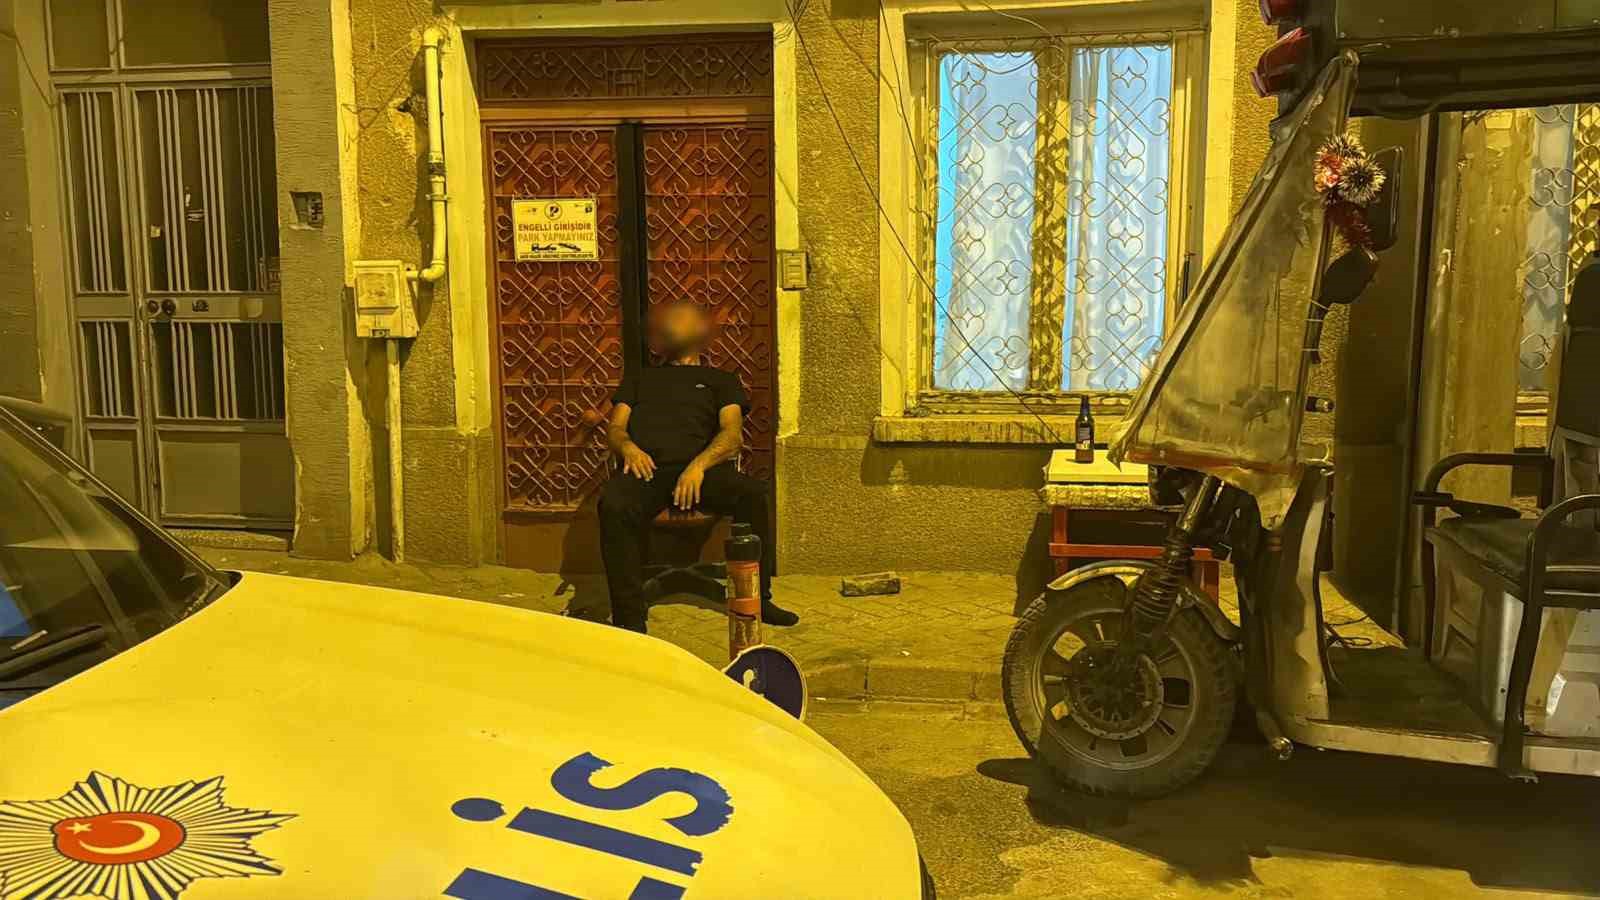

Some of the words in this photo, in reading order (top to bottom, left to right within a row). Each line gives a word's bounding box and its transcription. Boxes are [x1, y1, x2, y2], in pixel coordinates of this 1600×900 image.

[518, 222, 552, 231] ENGELLİ
[554, 221, 592, 232] GİRİŞİDİR
[518, 232, 540, 241] PARK
[542, 232, 594, 240] YAPMAYINIZ
